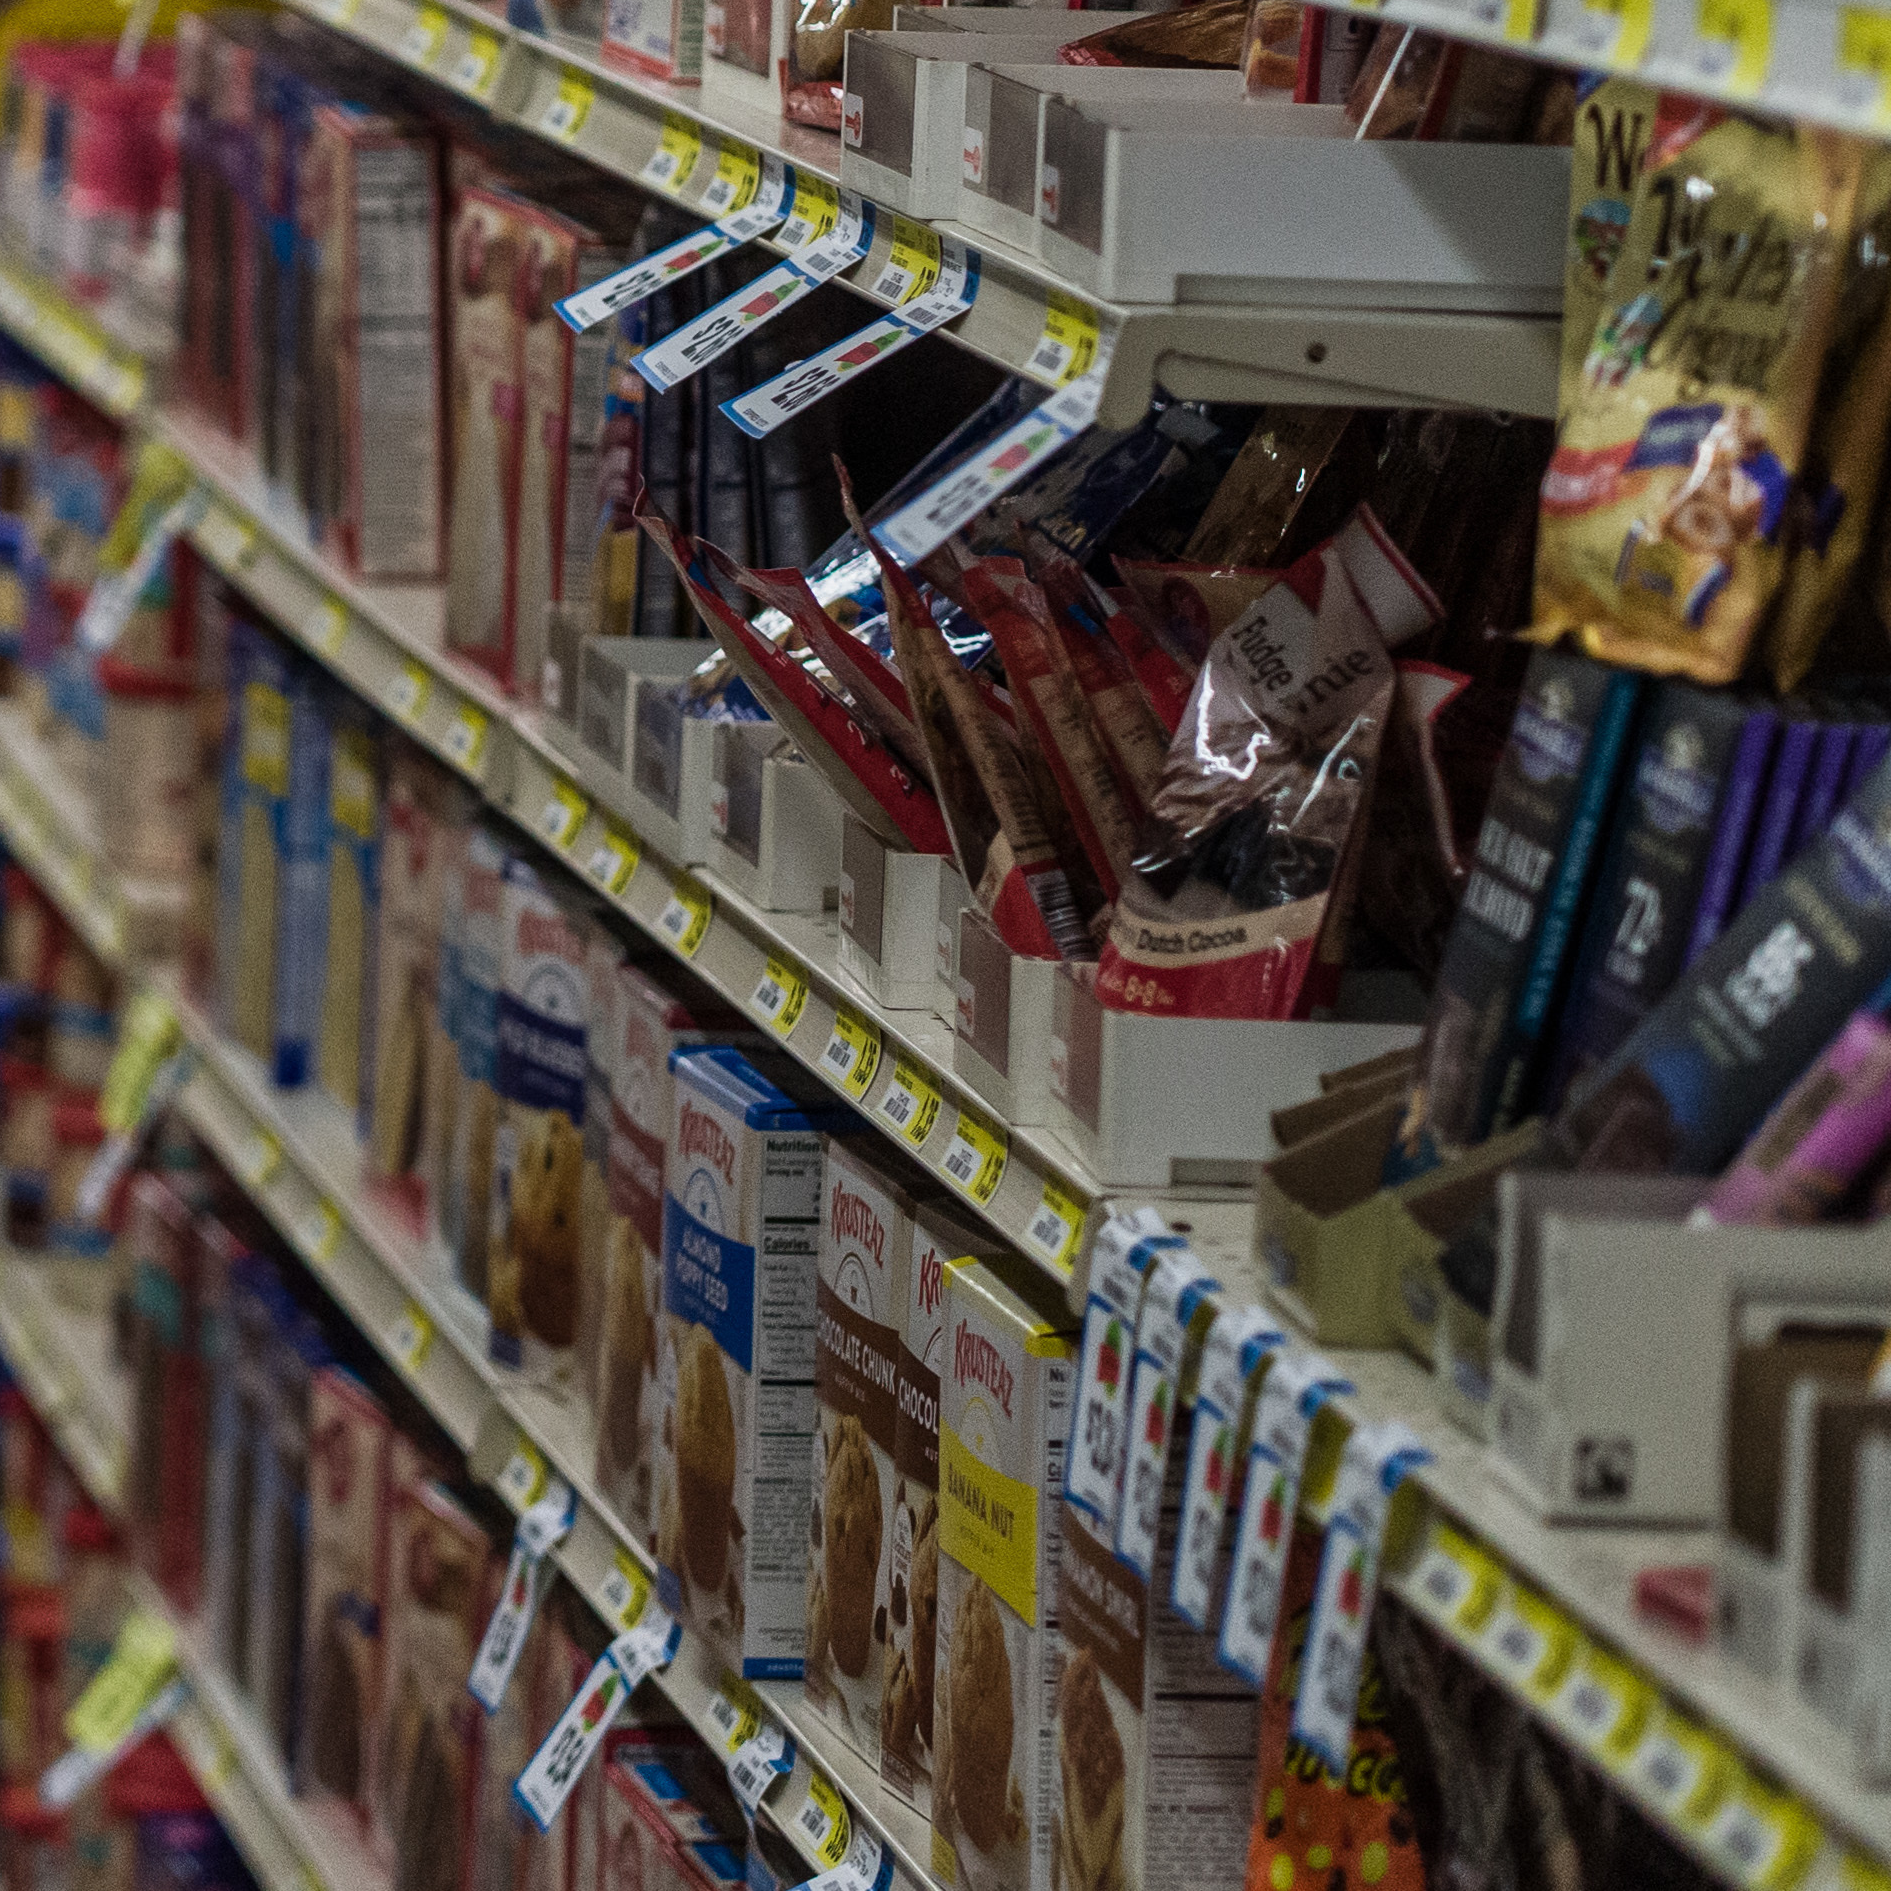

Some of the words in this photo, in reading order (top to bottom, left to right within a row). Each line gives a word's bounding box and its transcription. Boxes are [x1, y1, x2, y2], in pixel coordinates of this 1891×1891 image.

[1230, 614, 1293, 693] Fudge
[889, 764, 912, 791] 3
[1136, 928, 1184, 953] Dutch
[1188, 926, 1248, 952] Cocoa
[677, 1099, 736, 1187] KRUSTEAZ
[766, 1138, 822, 1153] Nutrition
[763, 1236, 812, 1251] Calories
[830, 1179, 885, 1270] KRUSTEAZ
[861, 1343, 897, 1397] CHUNK
[953, 1318, 1016, 1421] KRUSTEAZ
[897, 1375, 940, 1436] CHOCOL
[948, 1460, 989, 1526] BANANA
[990, 1497, 1016, 1544] NUT
